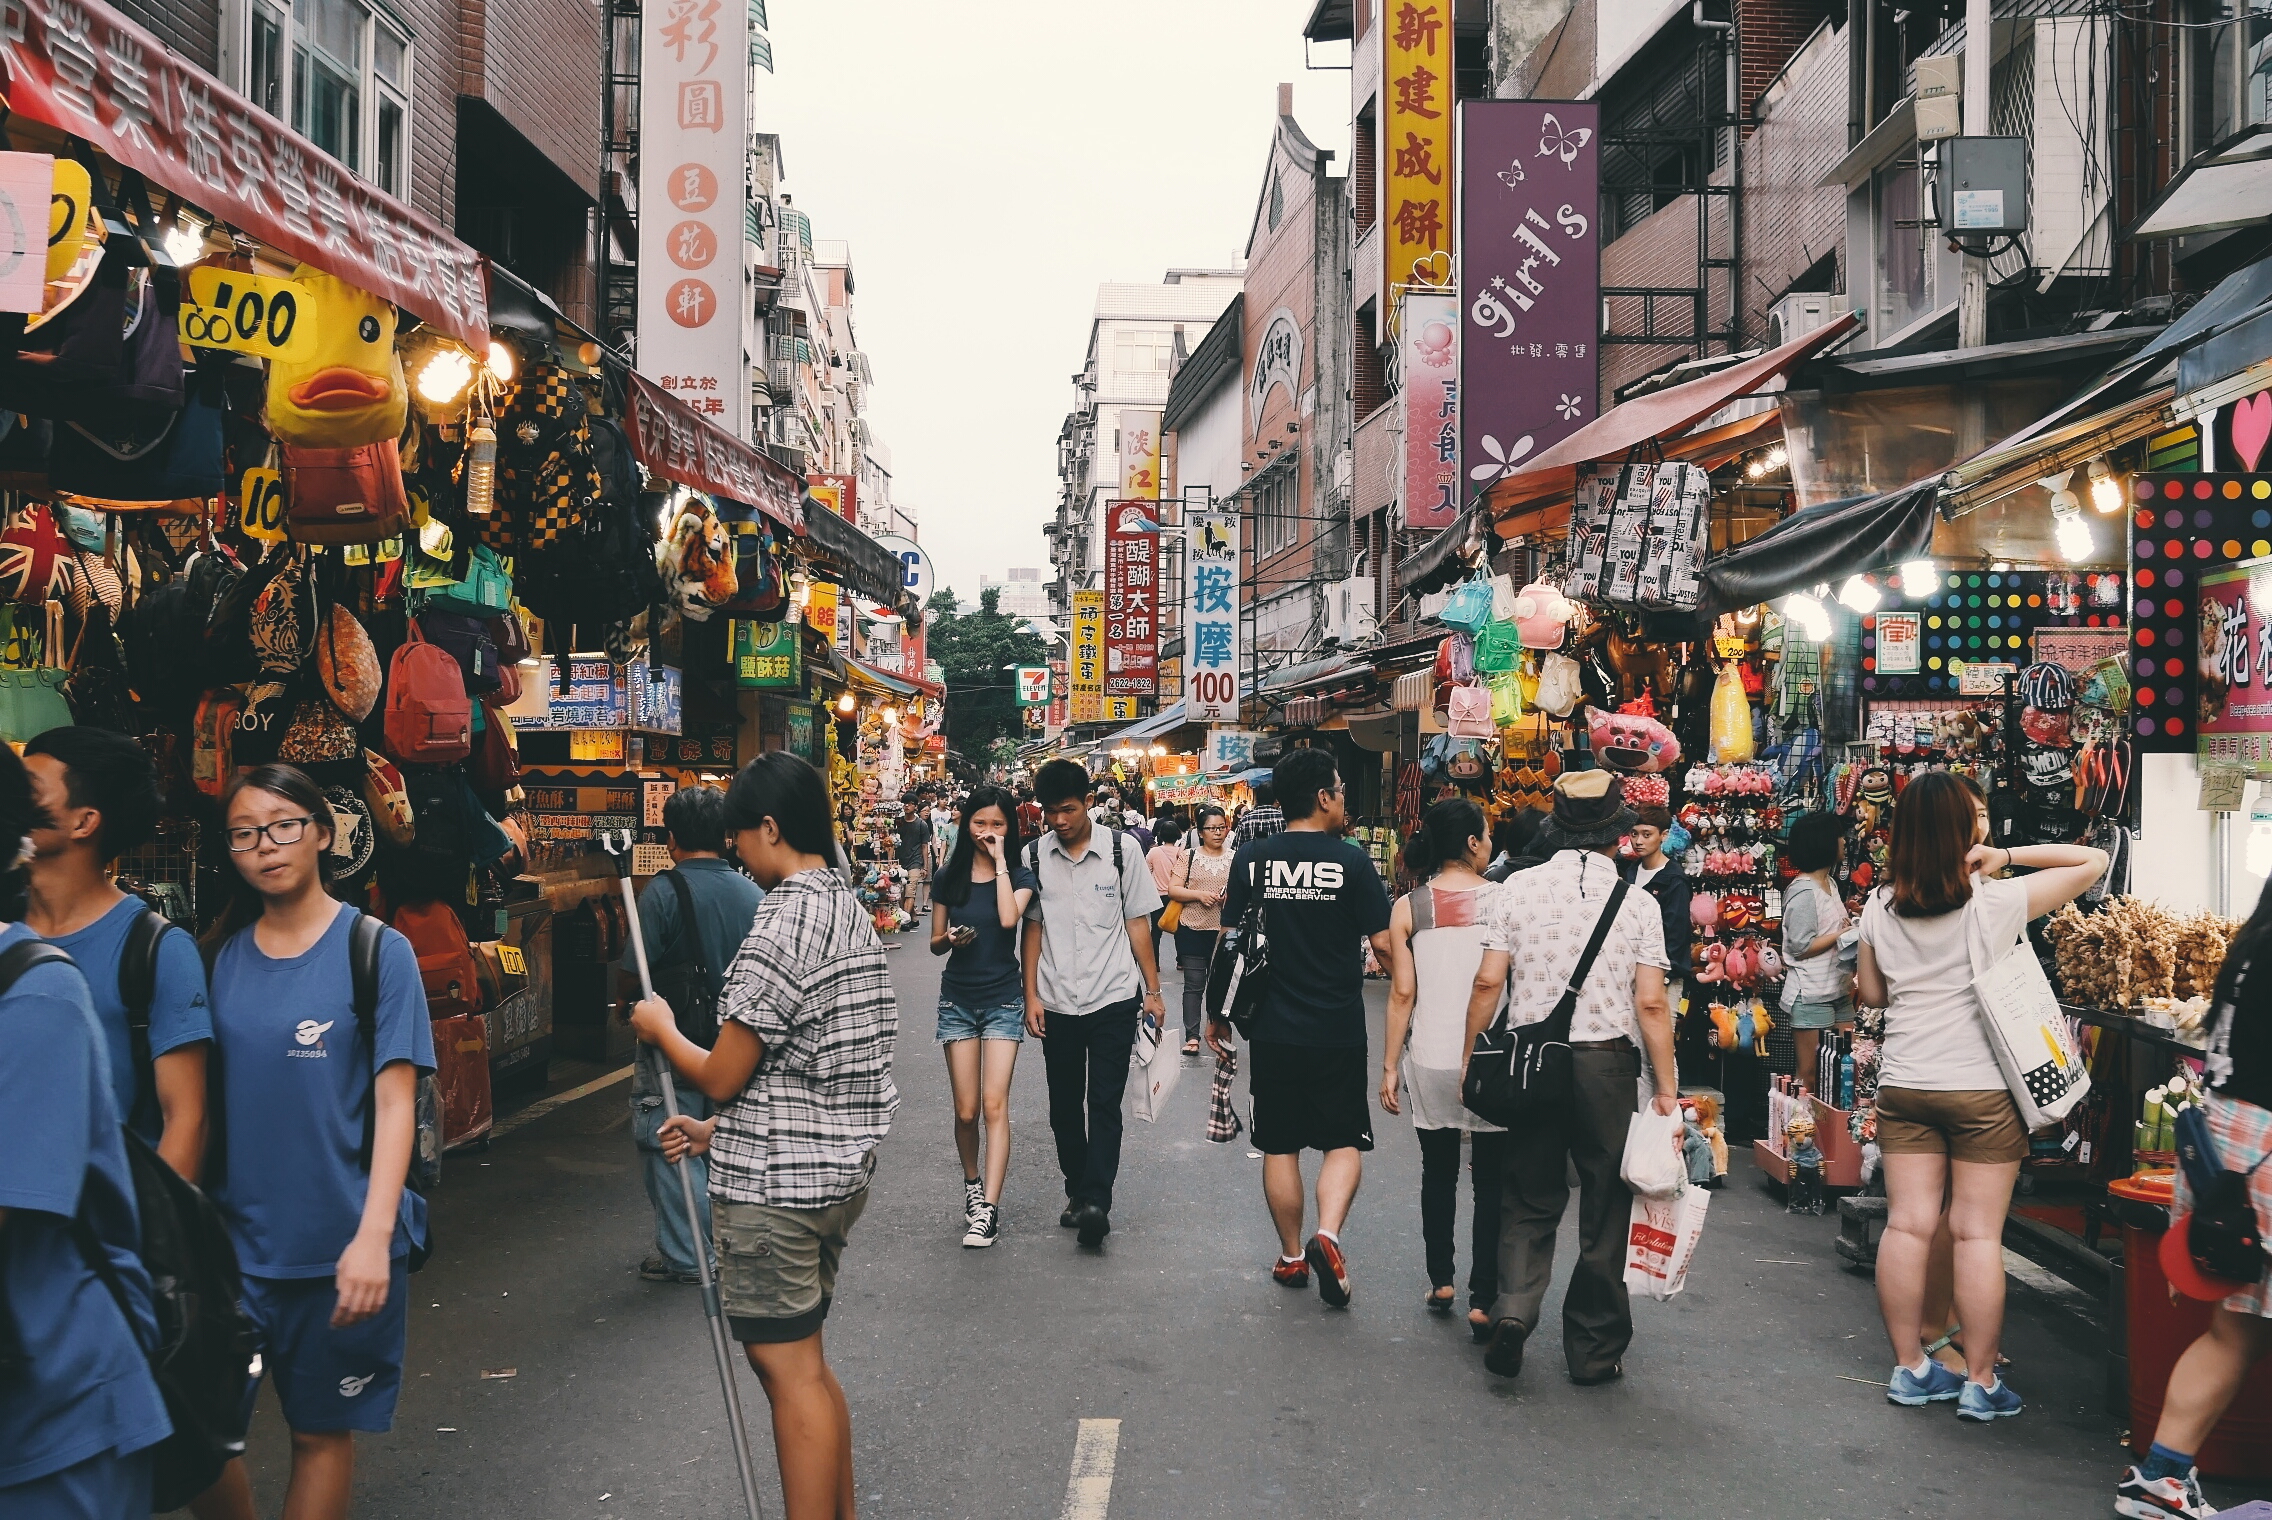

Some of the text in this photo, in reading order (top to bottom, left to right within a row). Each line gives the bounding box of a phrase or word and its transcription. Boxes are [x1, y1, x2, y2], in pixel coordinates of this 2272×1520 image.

[676, 168, 708, 324] 豆花軒
[661, 375, 718, 391] 創立於
[681, 397, 725, 416] 5年
[1127, 429, 1155, 500] 淡江
[1125, 538, 1151, 640] 醍醐大師
[1108, 593, 1125, 640] 第一名
[1193, 564, 1234, 669] 按摩
[741, 656, 790, 677] 鹽酥菇
[1109, 678, 1152, 689] 2622-1822
[1190, 672, 1234, 703] 100
[550, 706, 609, 723] 岩燒海苔
[1204, 705, 1220, 718] 元
[1263, 892, 1337, 901] EDICAL SERVICE
